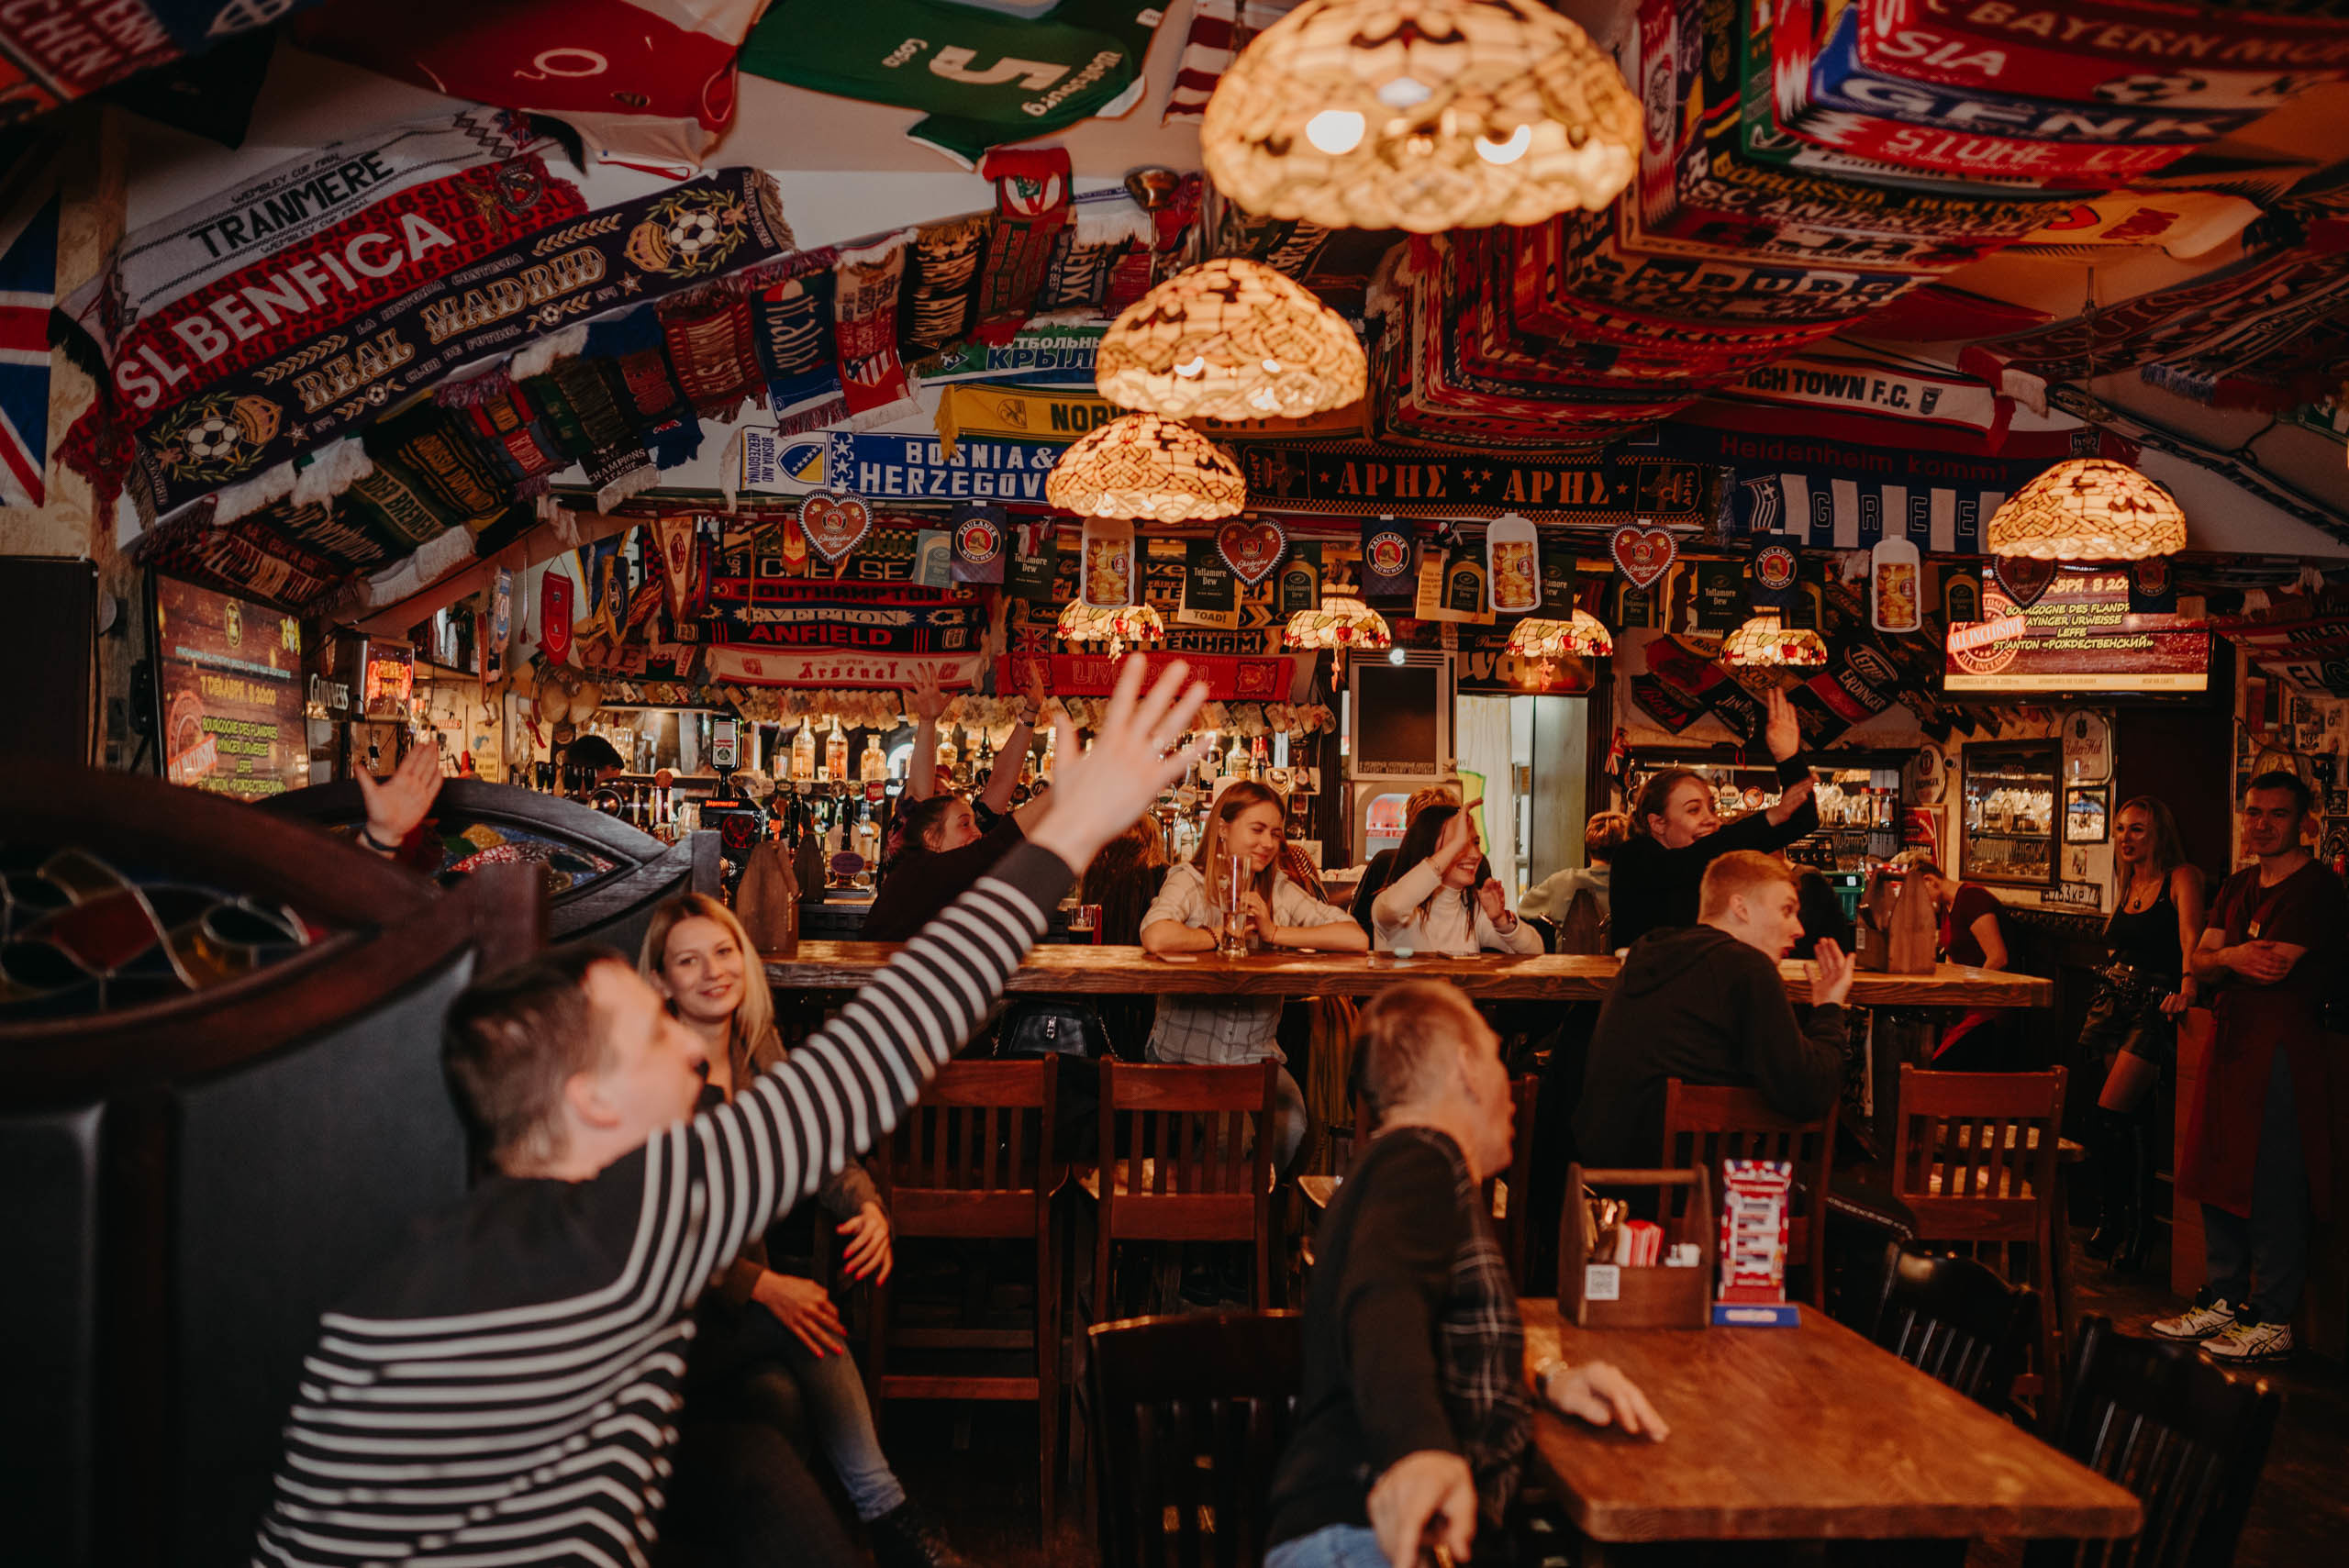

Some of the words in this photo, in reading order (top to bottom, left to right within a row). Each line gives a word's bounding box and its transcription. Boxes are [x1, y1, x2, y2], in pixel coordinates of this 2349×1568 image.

[1966, 0, 2222, 59] BAYERN
[231, 174, 289, 204] WEMBLEY
[291, 163, 310, 179] CUP
[188, 150, 395, 259] TRANMERE
[261, 225, 317, 254] WEMBLEY
[318, 216, 338, 229] CUP
[171, 212, 457, 364] BENFICA
[291, 327, 417, 416] REAL
[418, 245, 607, 346] MADRID
[986, 347, 1097, 371] КРЫЛ
[1792, 370, 1866, 402] TOWN
[1870, 381, 1911, 411] F.C.
[746, 431, 761, 484] HERZEGOVINA
[761, 437, 774, 463] BOSNIA
[905, 440, 1025, 470] BOSNIA
[1719, 435, 1894, 473] Heidenheim
[1908, 454, 2009, 484] kommt
[587, 448, 647, 484] CHAMPIONS
[604, 462, 640, 484] LEAGUE
[763, 464, 774, 484] AND
[859, 461, 1043, 496] HERZEGOV
[1336, 461, 1448, 499] ΑΡΗΣ
[1501, 469, 1609, 506] ΑΡΗΣ
[959, 519, 998, 538] PAULANER
[1370, 532, 1407, 551] PAULANER
[962, 550, 995, 562] MÜNCHEN
[1758, 548, 1793, 563] PAULANER
[1021, 563, 1038, 573] Dew
[1193, 566, 1228, 579] Tullamore
[1202, 576, 1218, 587] Dew
[1704, 587, 1737, 599] Tullamore
[750, 607, 899, 626] EVERTON
[1193, 610, 1228, 624] TOAD!
[2005, 604, 2066, 617] BOURGOGNE
[2068, 604, 2088, 615] DES
[2025, 616, 2068, 627] AYINGER
[2071, 614, 2122, 626] URWEISSE
[747, 625, 894, 646] ANFIELD
[2056, 628, 2087, 639] LEFFE
[798, 661, 899, 680] Arsenal
[309, 673, 350, 711] GUINNESS
[1837, 668, 1887, 713] ERDINGER
